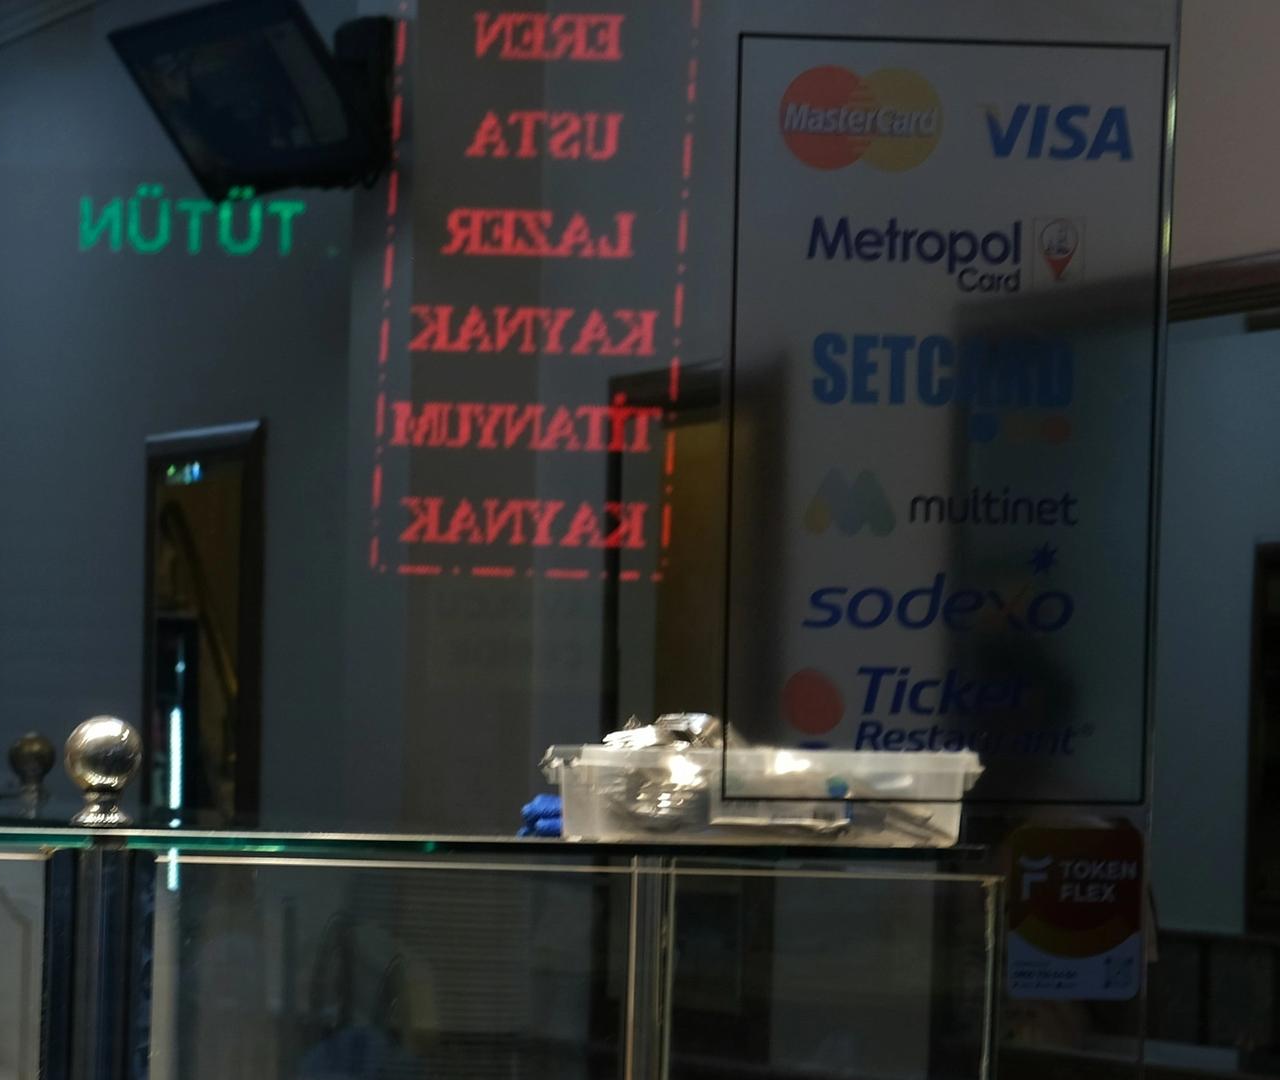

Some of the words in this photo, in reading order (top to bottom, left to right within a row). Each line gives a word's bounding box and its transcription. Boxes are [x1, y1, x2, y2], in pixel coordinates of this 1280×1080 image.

[783, 101, 937, 138] MasterCard
[986, 103, 1135, 162] VISA
[806, 215, 1022, 274] Metropol
[957, 267, 1021, 293] Card
[908, 487, 1080, 527] multinet
[801, 573, 1075, 632] sodexo
[856, 665, 1033, 717] Ticket
[1059, 860, 1138, 880] TOKEN
[1058, 882, 1118, 903] FLEX
